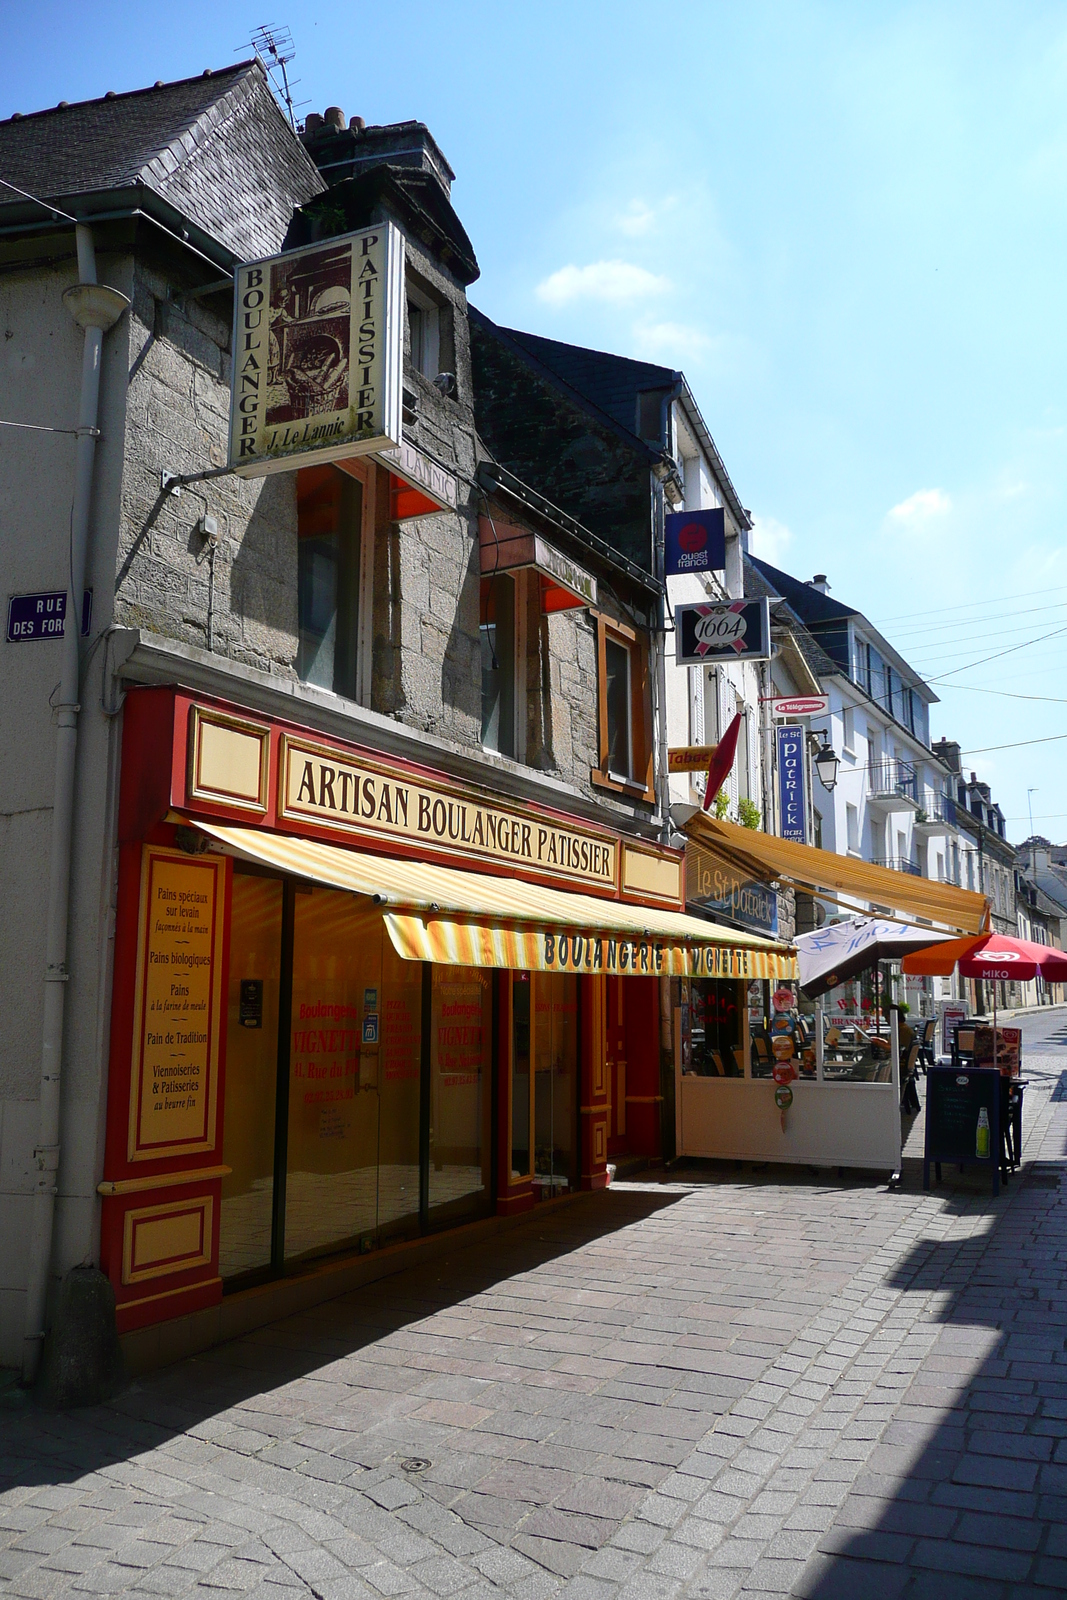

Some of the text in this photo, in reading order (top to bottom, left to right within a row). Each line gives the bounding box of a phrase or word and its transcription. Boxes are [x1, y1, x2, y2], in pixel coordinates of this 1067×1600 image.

[356, 235, 379, 431] PATISSIER
[239, 269, 264, 457] BOULANGER
[267, 415, 345, 450] J. Le Lannic
[406, 449, 457, 502] LANNIC
[677, 558, 709, 568] france
[681, 550, 708, 560] ouest
[36, 598, 63, 613] RUE
[13, 621, 34, 635] DES
[698, 616, 744, 638] 1664
[668, 751, 710, 765] Tabac
[296, 760, 611, 877] ARTISAN BOULANGER PATISSIER
[157, 887, 209, 905] Pains spéciaux
[166, 904, 200, 919] sur levain
[155, 919, 209, 935] façonnés à la main
[149, 951, 211, 969] Pains biologiques
[544, 932, 748, 975] BOULANGERIE VIGNETTE
[982, 969, 1009, 979] MIKO
[170, 983, 190, 997] Pains
[150, 998, 207, 1013] à la farine de meule
[300, 999, 357, 1022] Boulangerie
[441, 1002, 483, 1020] Boulangerie
[147, 1031, 208, 1046] Pain de Tradition
[294, 1030, 361, 1053] VIGNETTE
[437, 1027, 488, 1046] VIGNETTE
[152, 1063, 200, 1079] Viennoiseries
[307, 1062, 328, 1079] Rue
[330, 1061, 342, 1079] du
[152, 1079, 199, 1096] & Patisseries
[153, 1094, 196, 1112] au beurre fin
